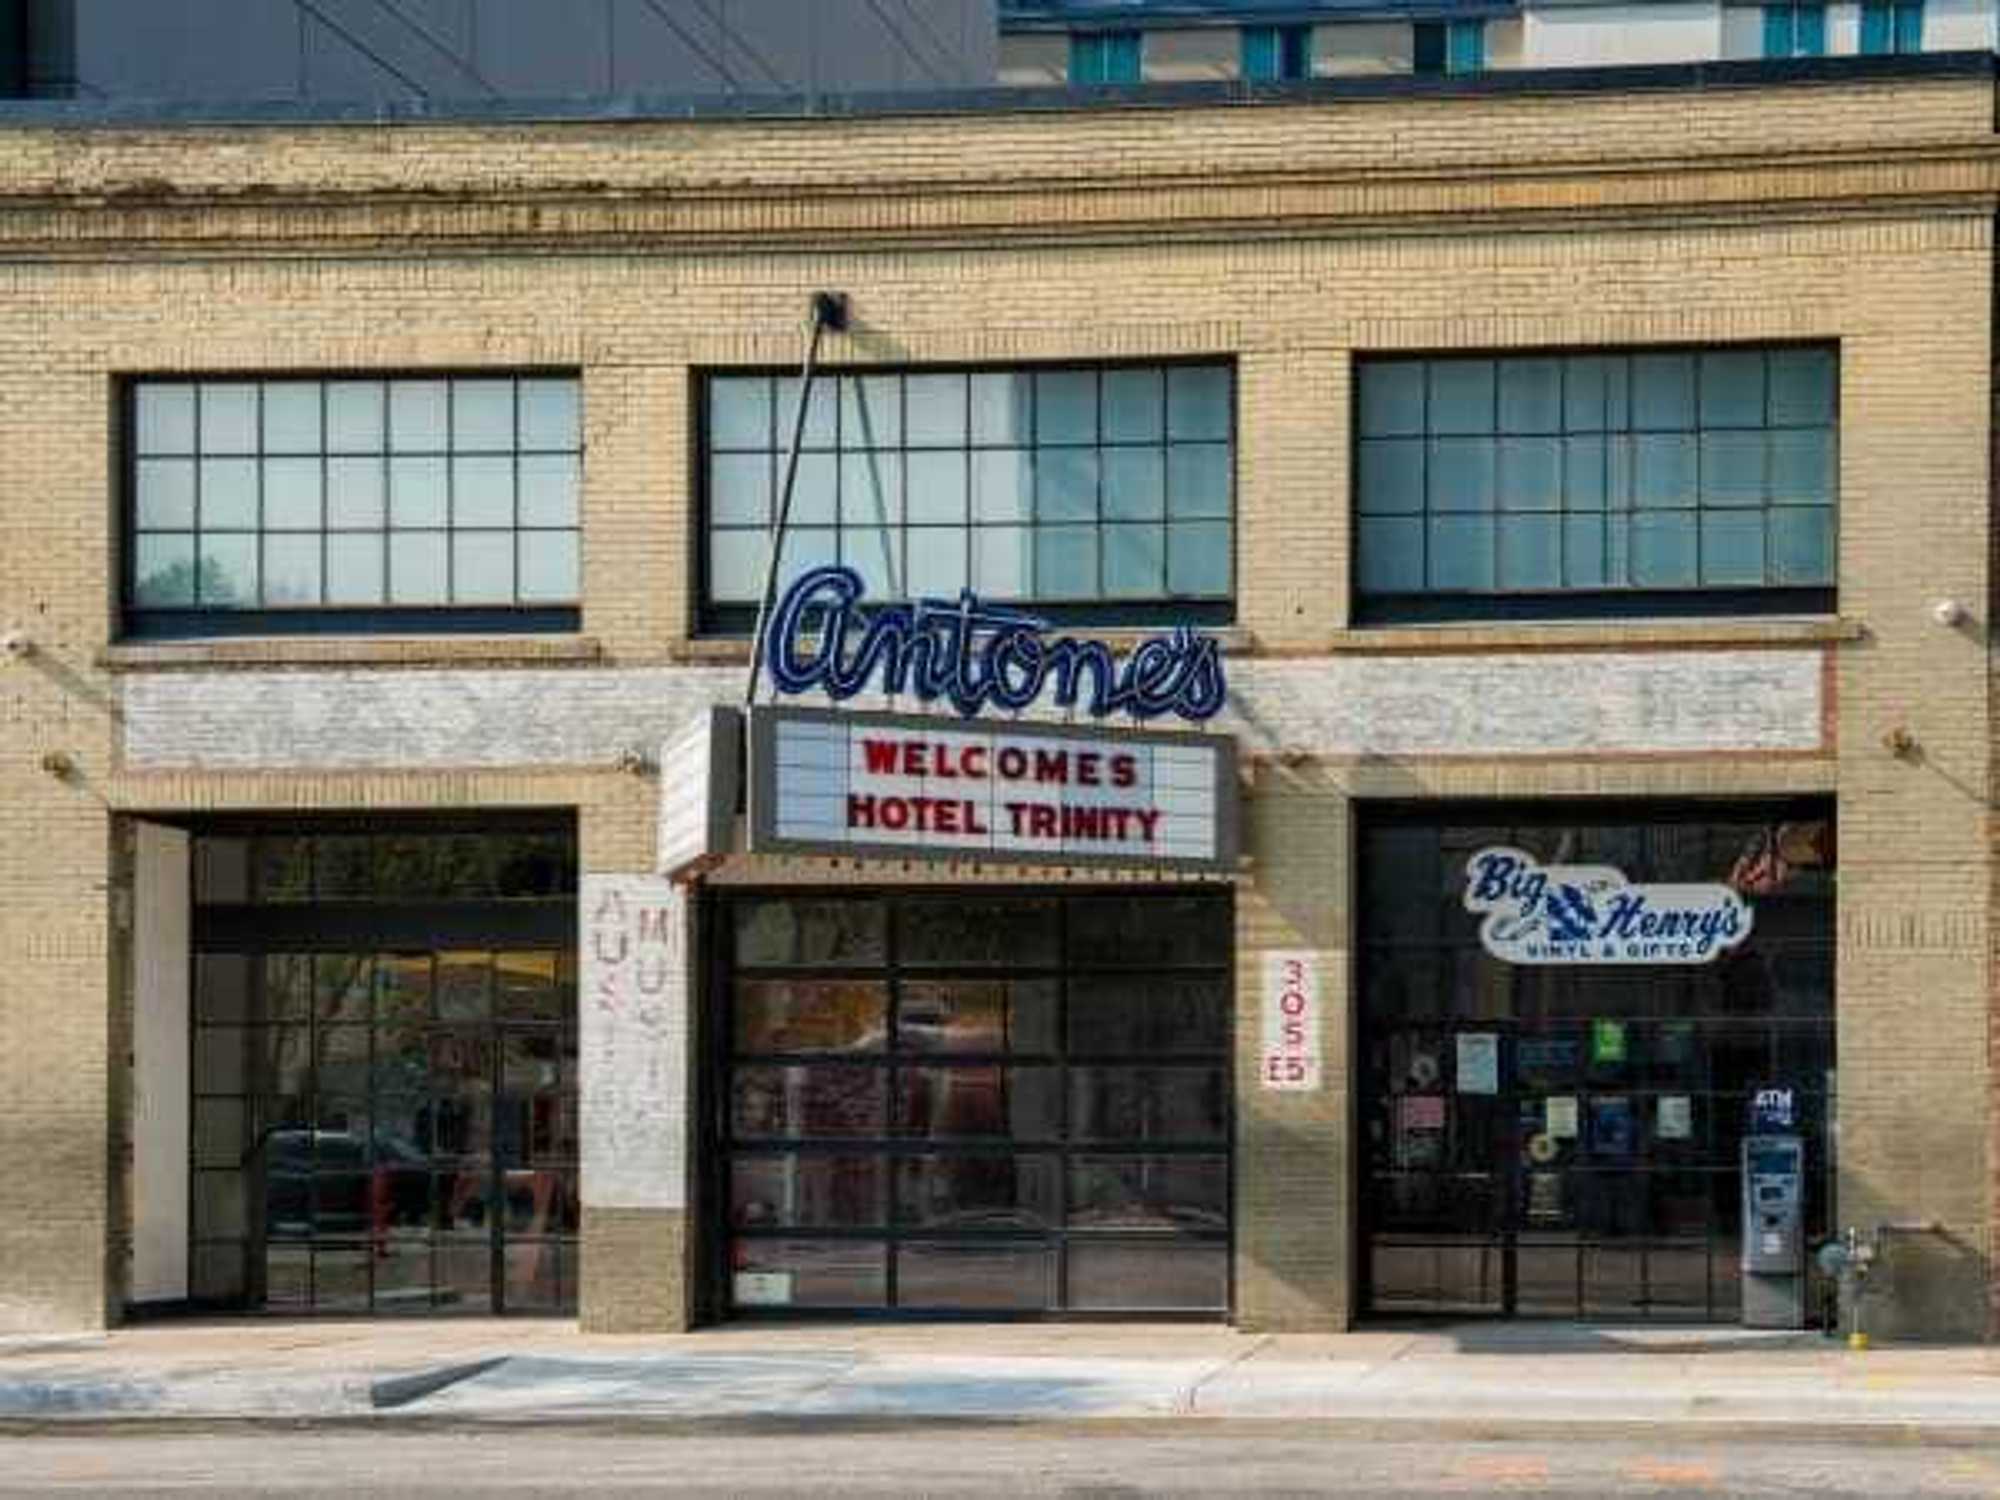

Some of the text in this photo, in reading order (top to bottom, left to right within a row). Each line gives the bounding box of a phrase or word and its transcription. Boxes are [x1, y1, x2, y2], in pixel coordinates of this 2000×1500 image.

[766, 566, 1227, 720] Antone's
[862, 738, 1138, 789] WELCOMES
[847, 793, 1162, 842] HOTEL TRINITY
[1473, 853, 1739, 956] Big Henry's
